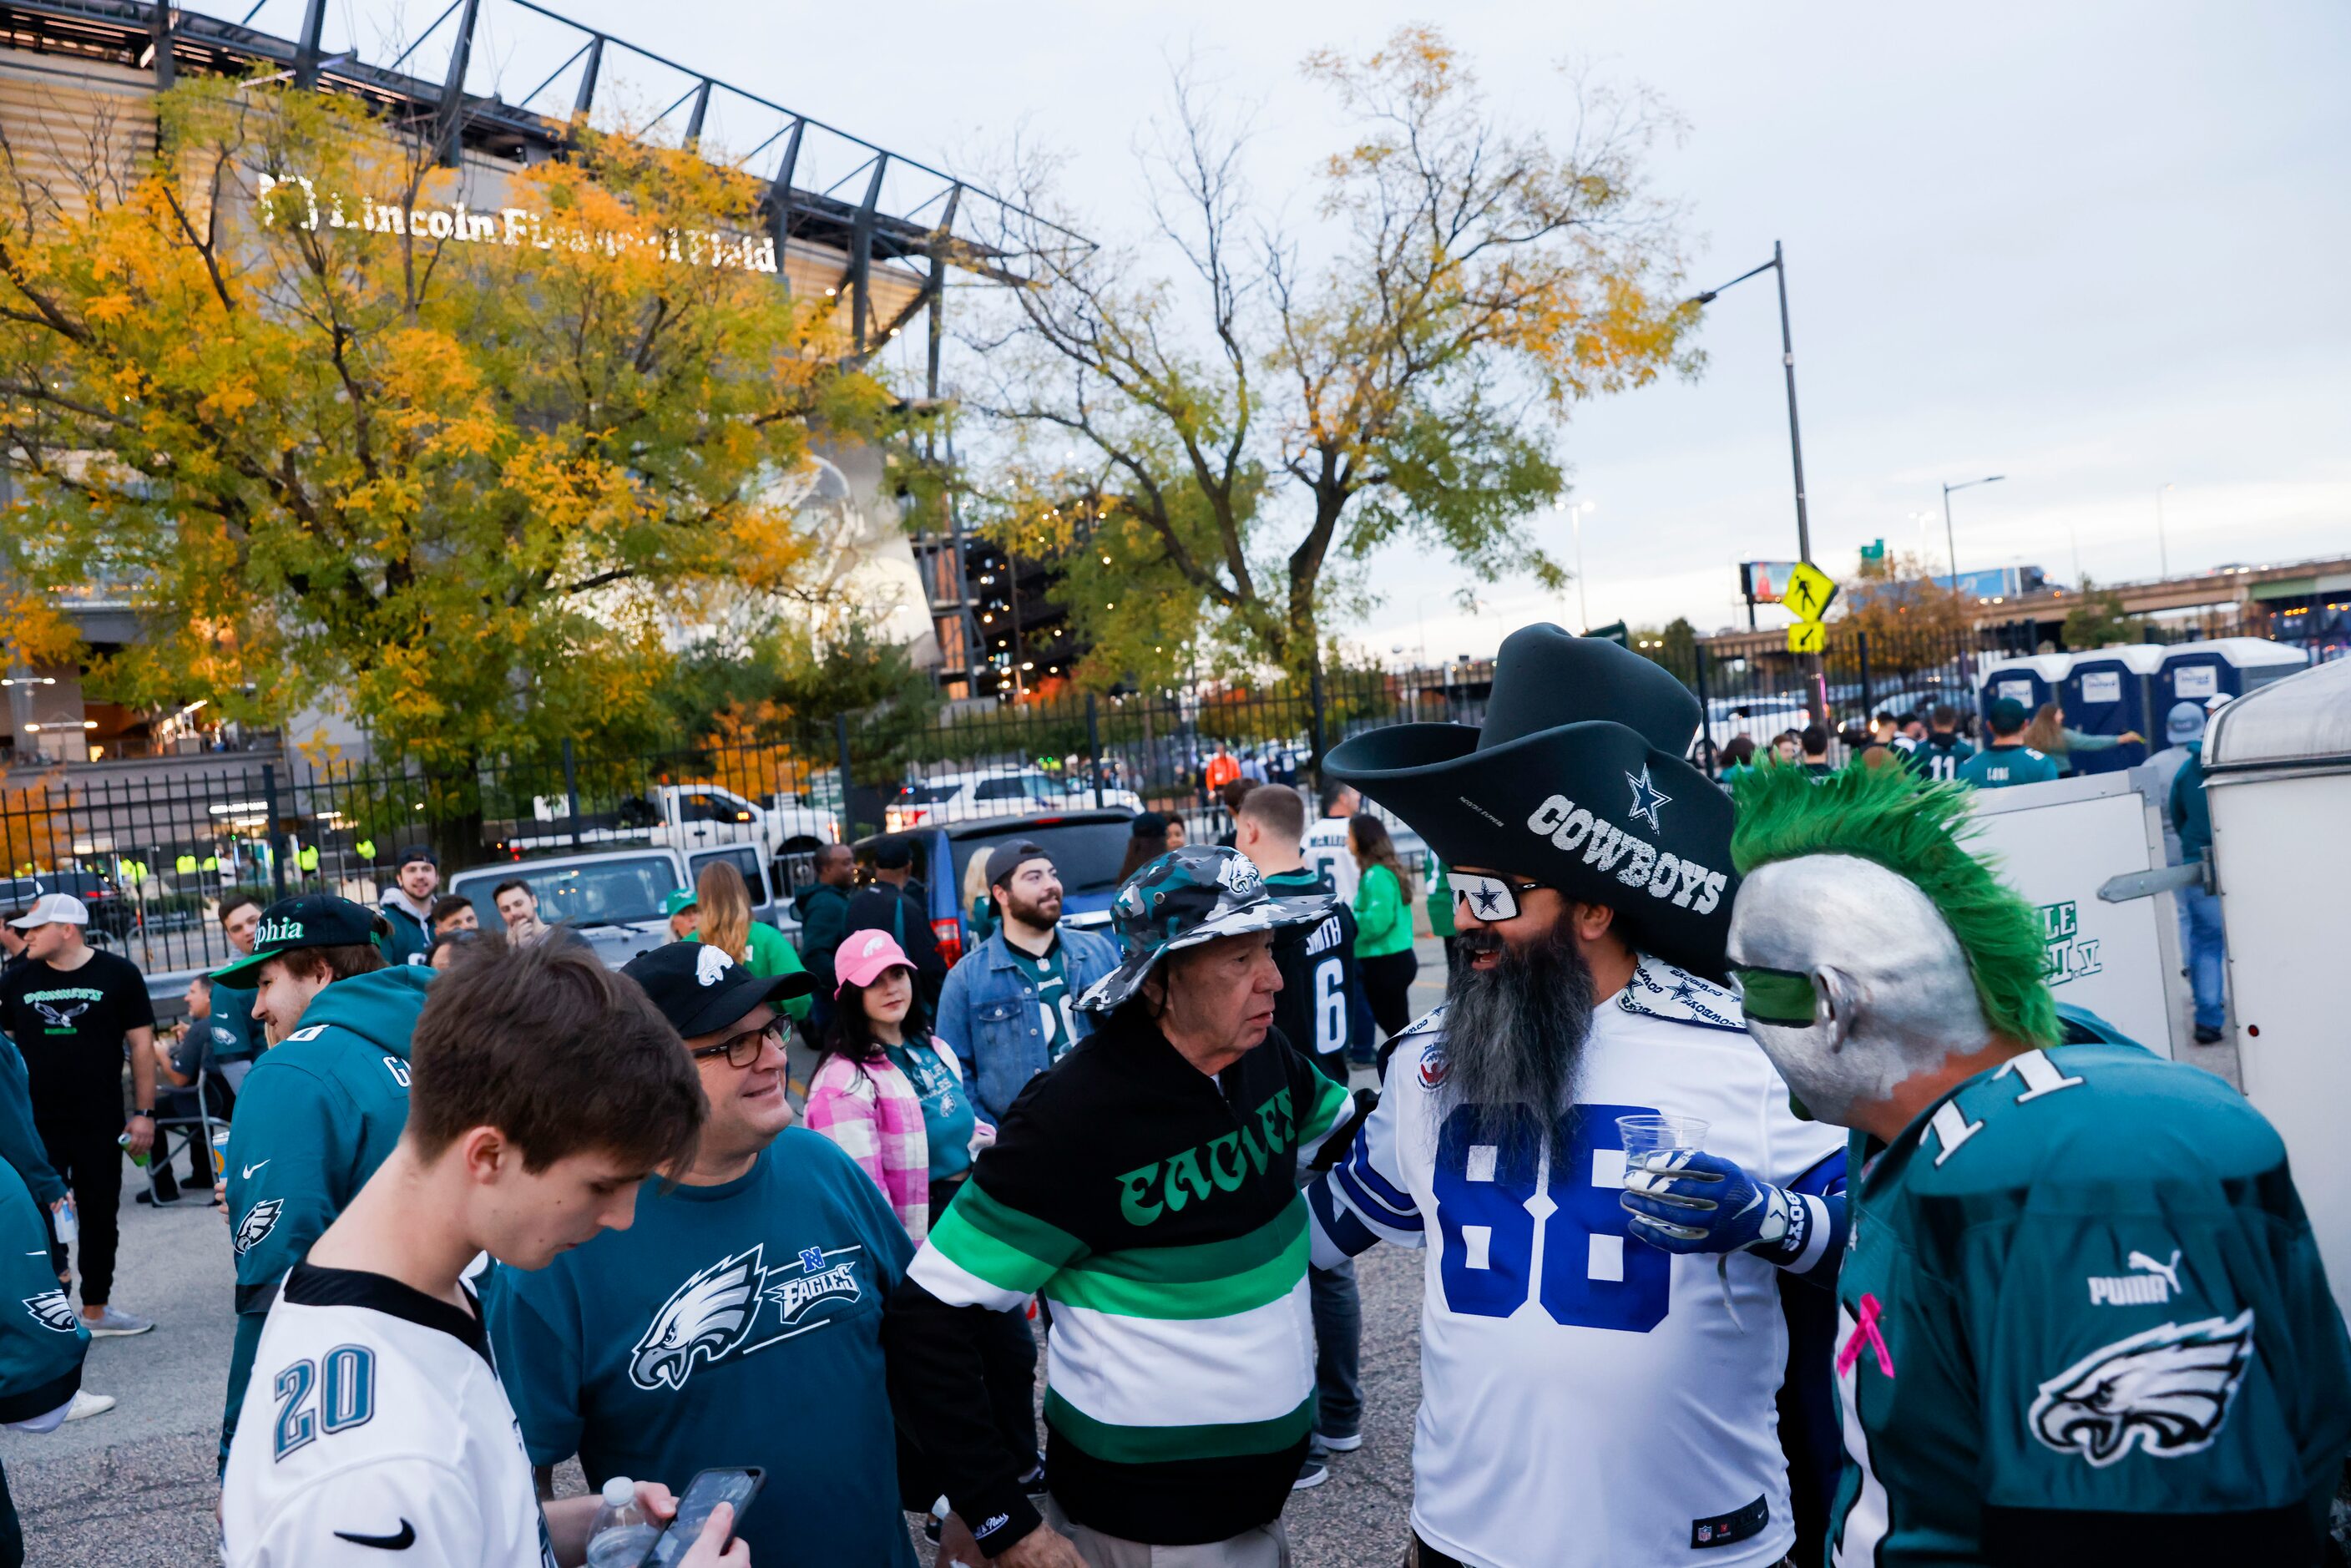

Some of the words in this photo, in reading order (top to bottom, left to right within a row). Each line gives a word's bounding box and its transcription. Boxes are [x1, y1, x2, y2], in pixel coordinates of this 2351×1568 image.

[1929, 755, 1956, 781] 11
[1527, 794, 1728, 915] COWBOYS
[1315, 957, 1347, 1055] 6
[1115, 1086, 1296, 1227] EAGLES
[1919, 1048, 2083, 1166] 11
[1432, 1102, 1671, 1333] 88
[771, 1264, 860, 1321] EAGLES
[2087, 1273, 2170, 1305] PUMA
[274, 1343, 376, 1464] 20
